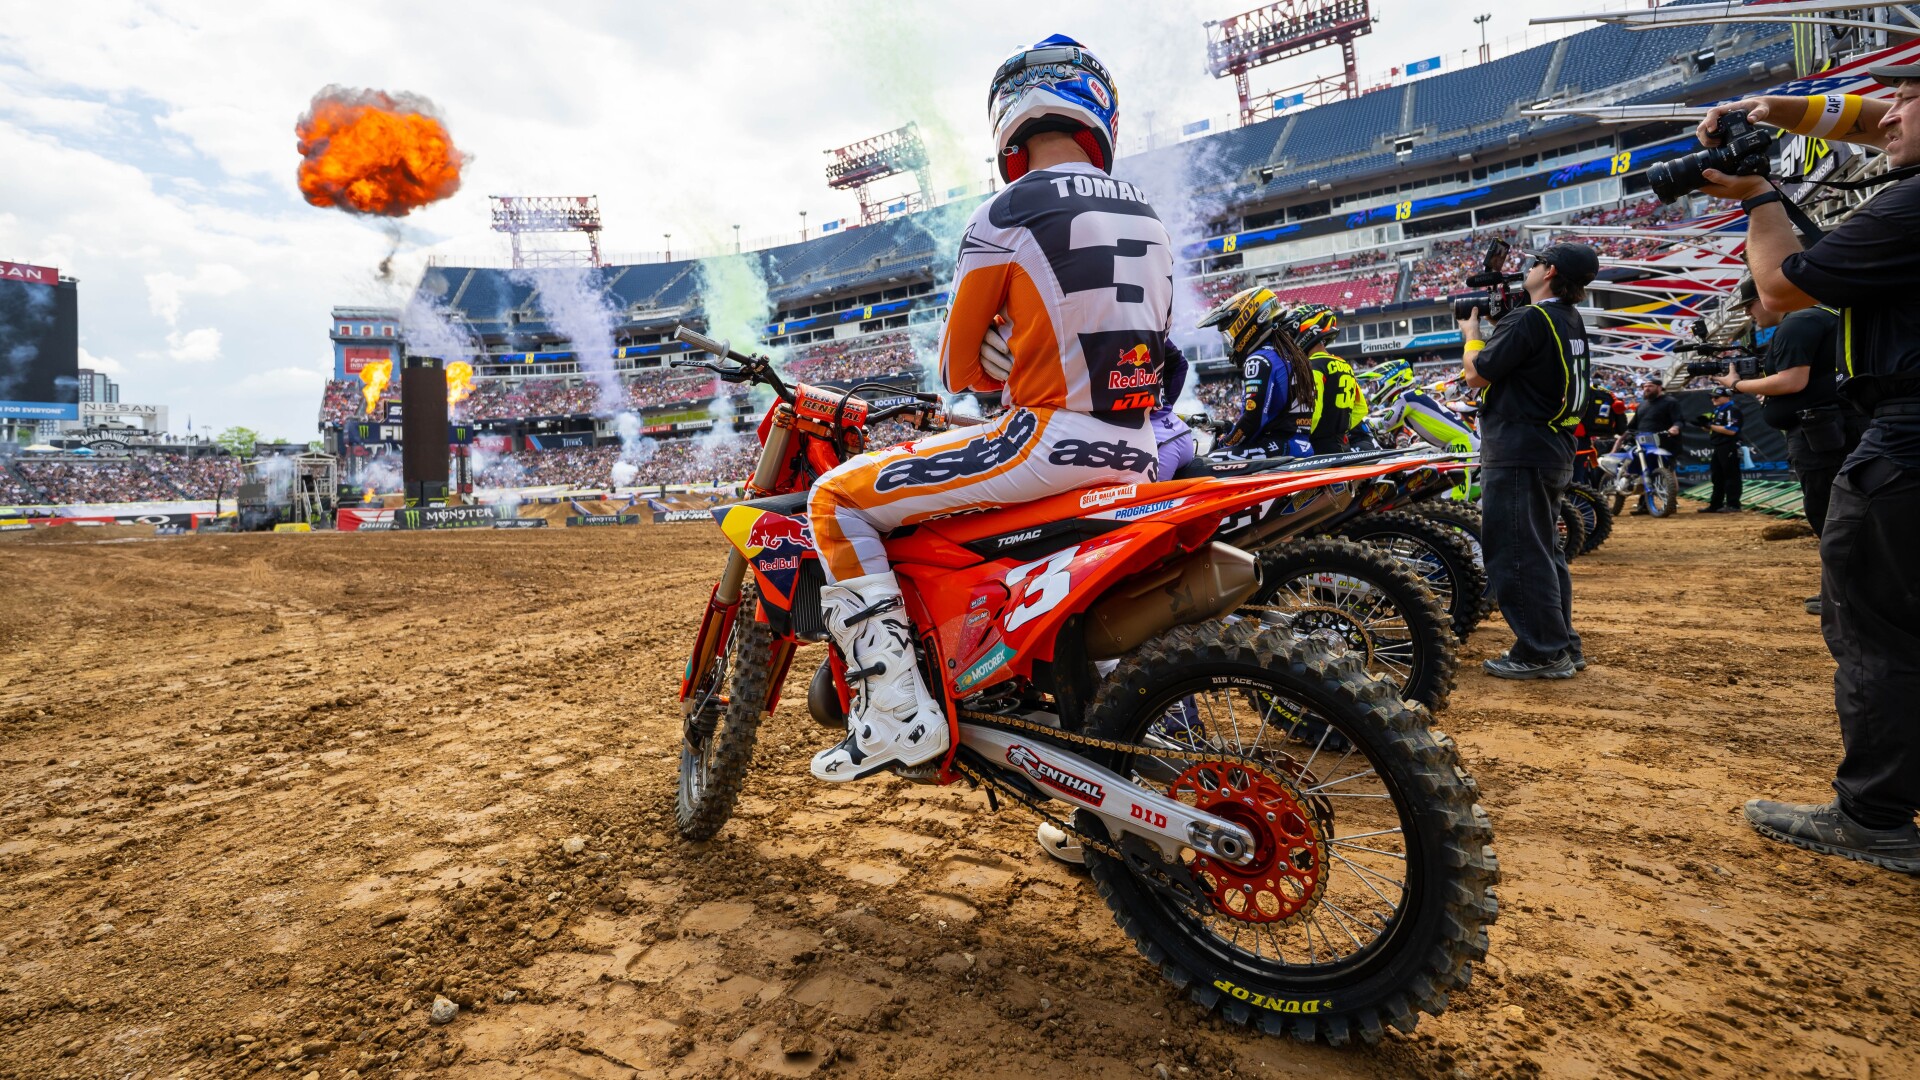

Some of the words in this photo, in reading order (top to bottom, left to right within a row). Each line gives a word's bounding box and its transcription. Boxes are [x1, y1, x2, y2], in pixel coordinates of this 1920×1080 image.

[1090, 80, 1108, 106] BELL
[1610, 152, 1631, 175] 13
[1395, 201, 1412, 220] 13
[1223, 236, 1237, 252] 13
[1066, 211, 1172, 332] 3
[863, 306, 873, 319] 13
[1232, 299, 1260, 334] 100%
[777, 322, 786, 335] 13
[618, 346, 627, 359] 13
[1363, 340, 1401, 352] Pinnacle
[525, 352, 535, 364] 13
[84, 403, 156, 413] NISSAN
[874, 398, 896, 407] ROCKY
[897, 396, 912, 405] LAW
[1112, 391, 1155, 411] KTM
[802, 400, 862, 422] RENTAL
[1288, 457, 1337, 470] DUNLOP
[1082, 494, 1098, 506] SELLE
[1117, 485, 1134, 497] VALLE
[426, 505, 493, 521] MONSTER
[1114, 499, 1175, 520] PROGRESSIVE
[438, 520, 486, 528] ENERGY
[997, 529, 1042, 549] TOMAC
[759, 558, 779, 571] Red
[779, 556, 798, 569] Bull
[1003, 545, 1081, 633] 3
[971, 649, 1005, 680] MOTOREX
[1213, 980, 1320, 1013] DUNLOP
